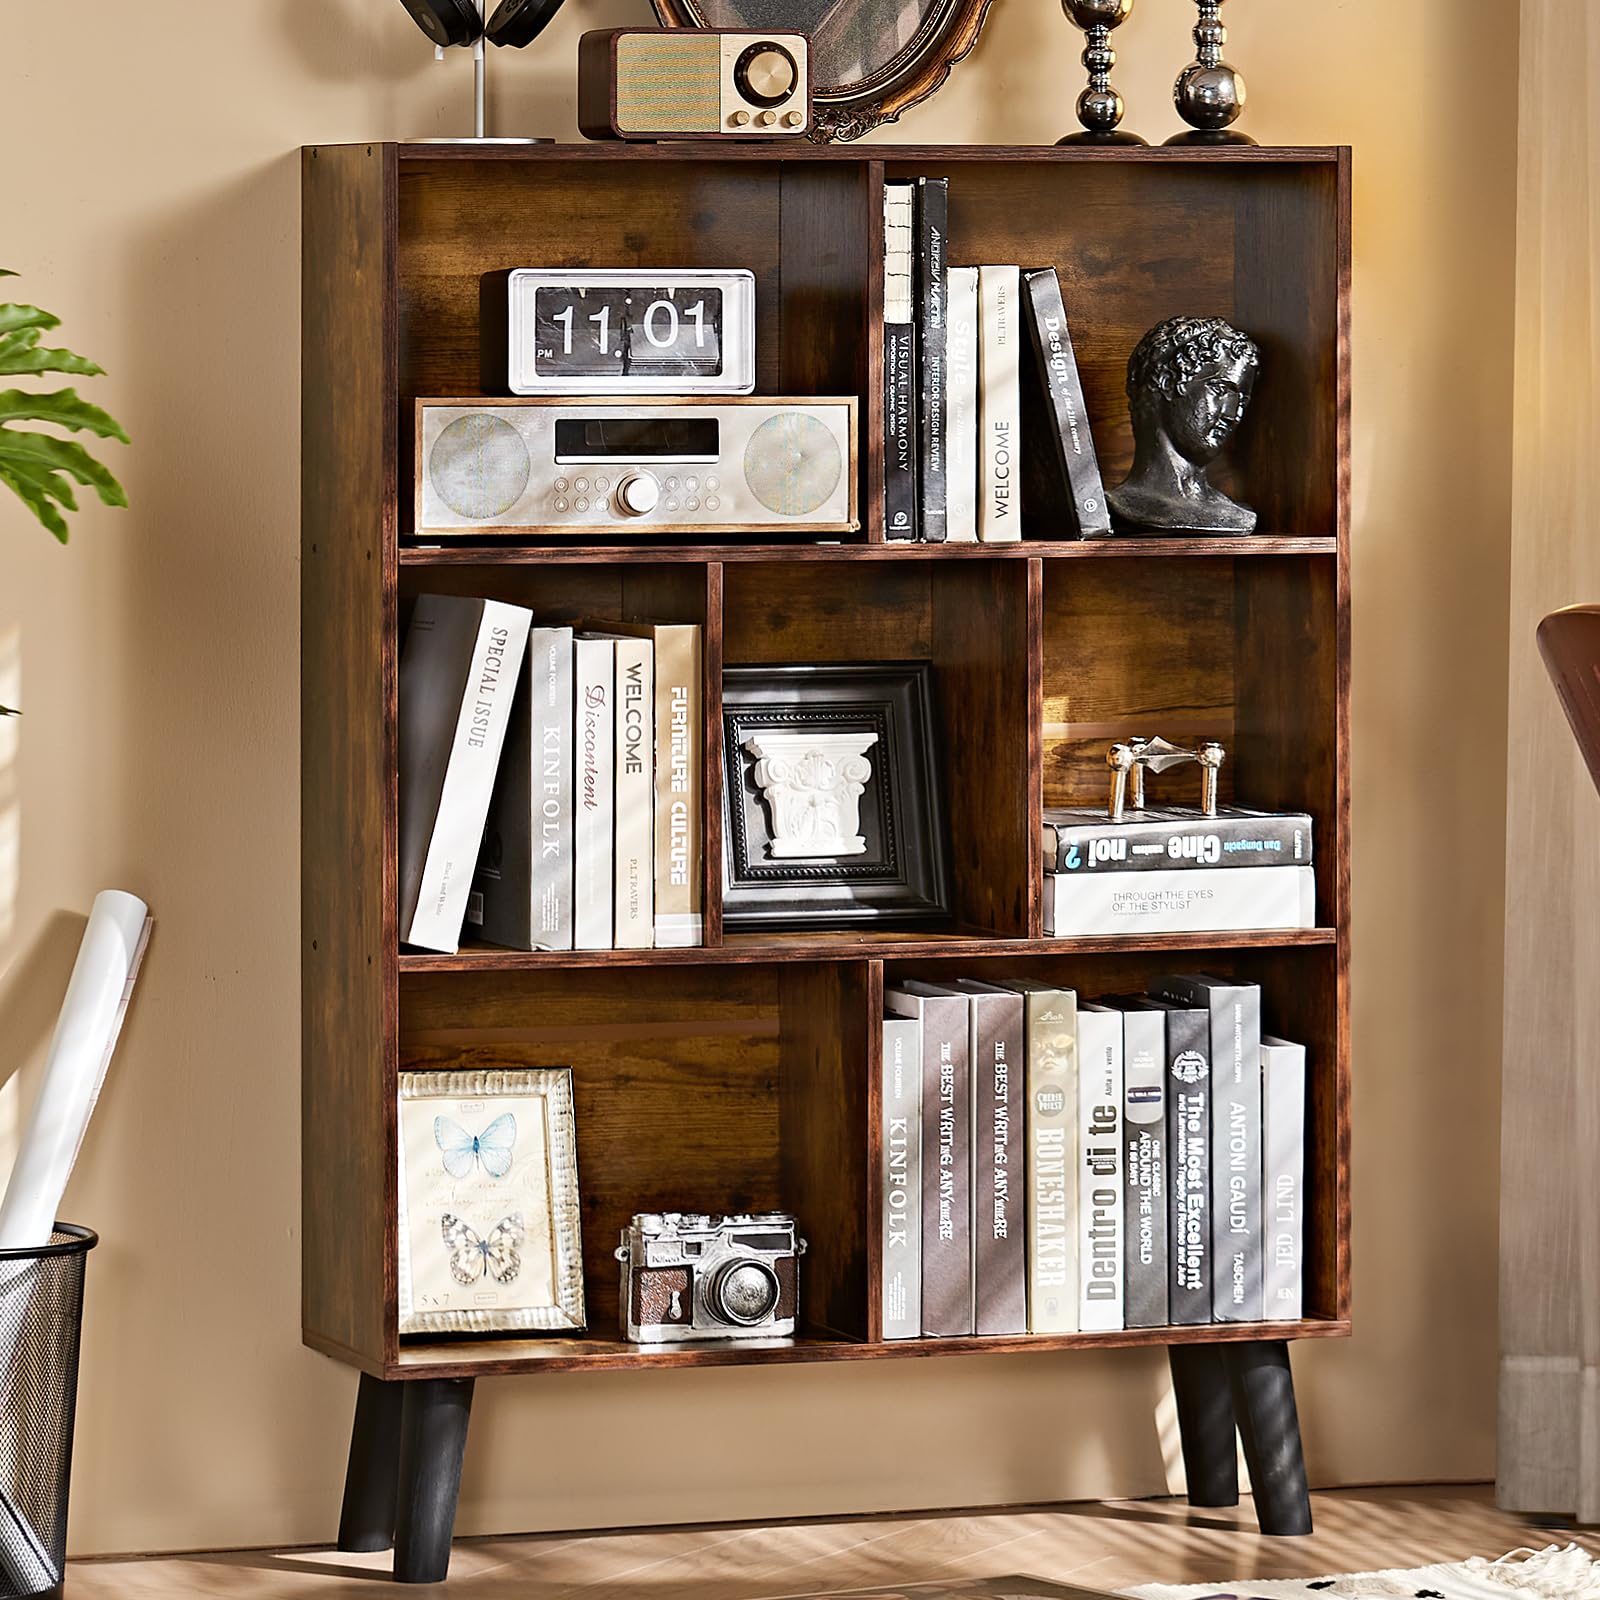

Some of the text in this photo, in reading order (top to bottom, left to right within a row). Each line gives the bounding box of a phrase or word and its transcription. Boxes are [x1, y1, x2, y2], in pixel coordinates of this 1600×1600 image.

[930, 282, 941, 329] MARTIN
[537, 349, 553, 358] PM
[950, 319, 971, 385] Style
[1044, 316, 1070, 385] Design
[890, 375, 896, 383] IN
[1061, 388, 1072, 397] of
[898, 335, 909, 472] VISUAL HARMONY
[931, 356, 939, 472] INTERIOR DESIGN REVIEW
[1064, 397, 1074, 410] the
[1070, 427, 1082, 455] century
[994, 421, 1010, 518] WELCOME
[467, 627, 508, 748] SPECIAL ISSUE
[625, 663, 642, 775] WELCOME
[583, 685, 606, 811] Discontent
[542, 725, 561, 859] KINFOLK
[670, 687, 688, 886] FURNITURE CULTURE
[1087, 837, 1127, 868] noi
[1167, 834, 1220, 864] Cine
[1112, 900, 1191, 912] OF THE STYLIST
[1113, 889, 1214, 902] THROUGH THE EYES
[940, 1041, 951, 1061] THE
[995, 1041, 1005, 1060] THE
[940, 1064, 954, 1104] BEST
[994, 1063, 1008, 1103] BEST
[1177, 1093, 1186, 1111] and
[1152, 1140, 1161, 1158] ONE
[1229, 1101, 1250, 1234] ANTONI GAUDÍ
[888, 1116, 908, 1248] KINFOLK
[1129, 1162, 1139, 1186] DAYS
[1186, 1092, 1205, 1290] The Most Excellent
[1035, 1127, 1065, 1288] BONESHAKER
[1086, 1105, 1117, 1301] Dentro di te
[1139, 1131, 1153, 1265] AROUND THE WORLD
[1276, 1174, 1295, 1222] LIND
[1177, 1213, 1186, 1245] Romeo
[1177, 1246, 1186, 1264] and
[1275, 1233, 1295, 1269] JED
[1232, 1252, 1245, 1304] TASCHEN
